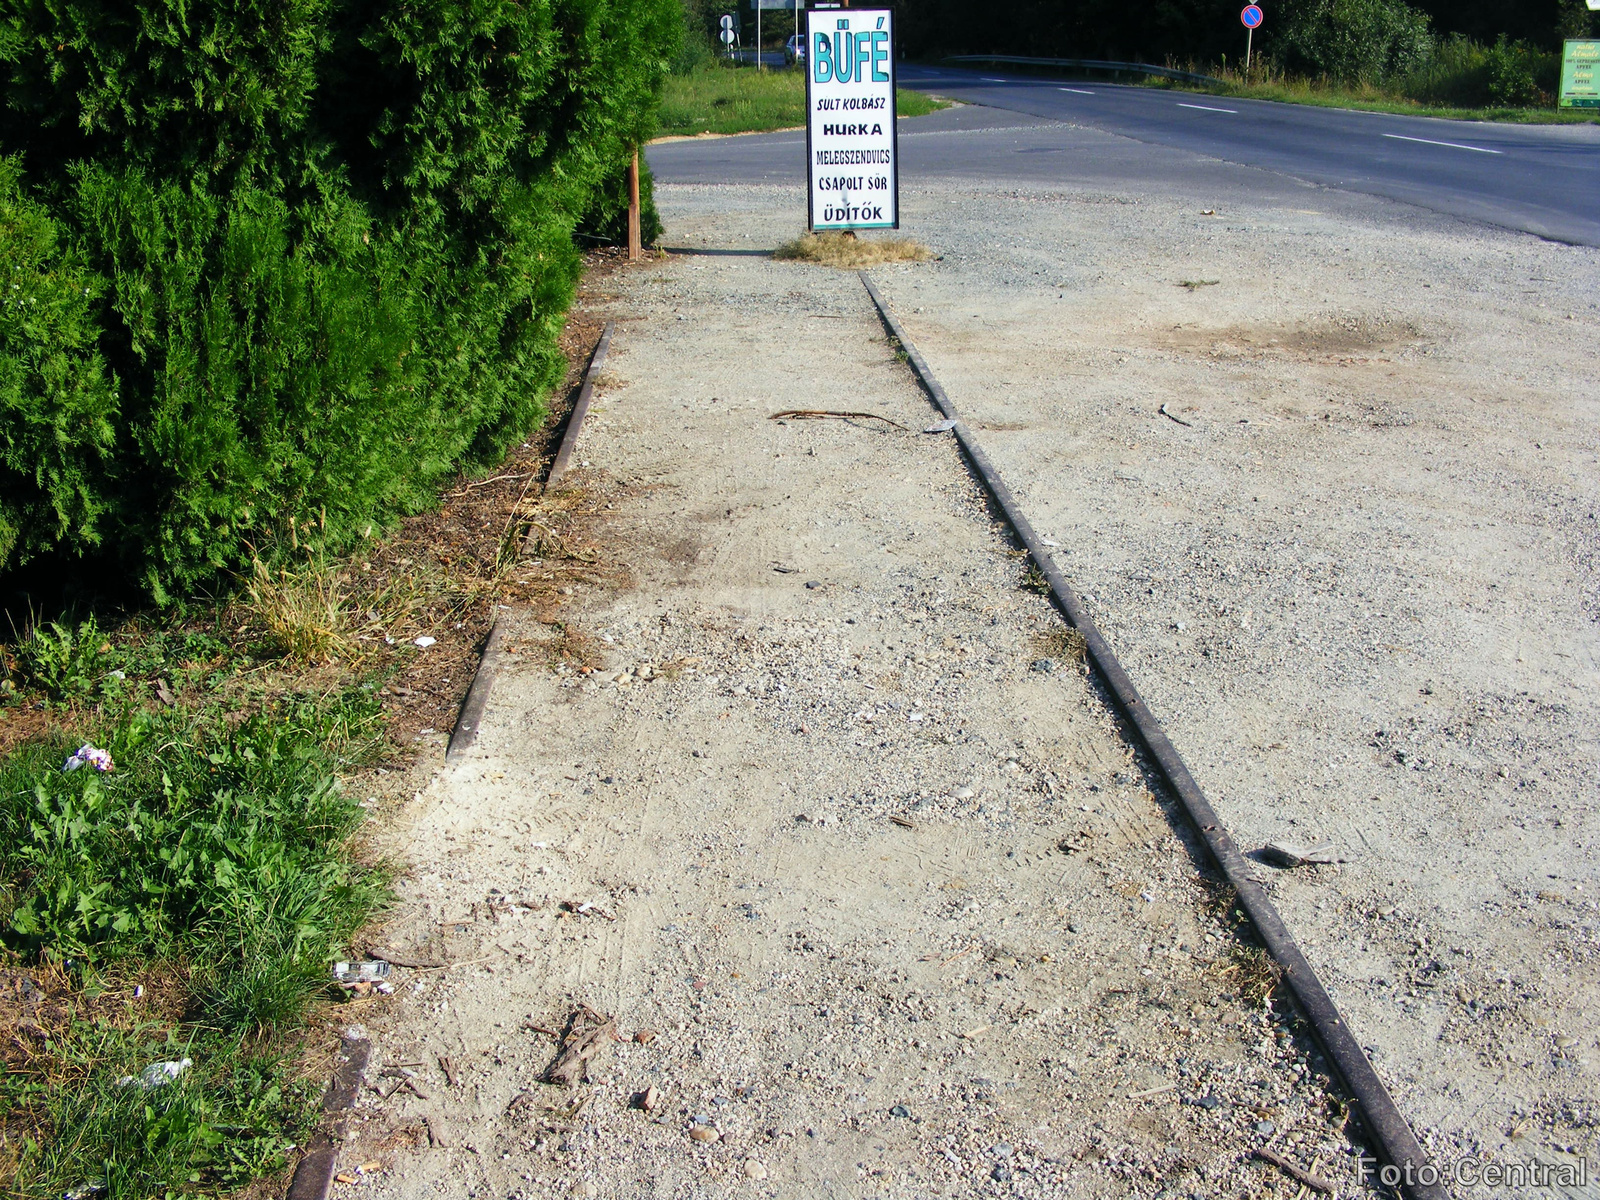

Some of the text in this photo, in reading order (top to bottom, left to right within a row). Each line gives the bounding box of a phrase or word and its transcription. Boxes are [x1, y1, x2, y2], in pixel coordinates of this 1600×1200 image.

[814, 17, 889, 83] BÜFÉ
[842, 94, 886, 111] KOLBÁSZ
[823, 123, 883, 136] HURKA
[816, 149, 890, 165] MELEGSZENDVICS
[819, 172, 888, 191] CSAPOLT SÖR
[824, 201, 883, 222] ÜDÍTŐK
